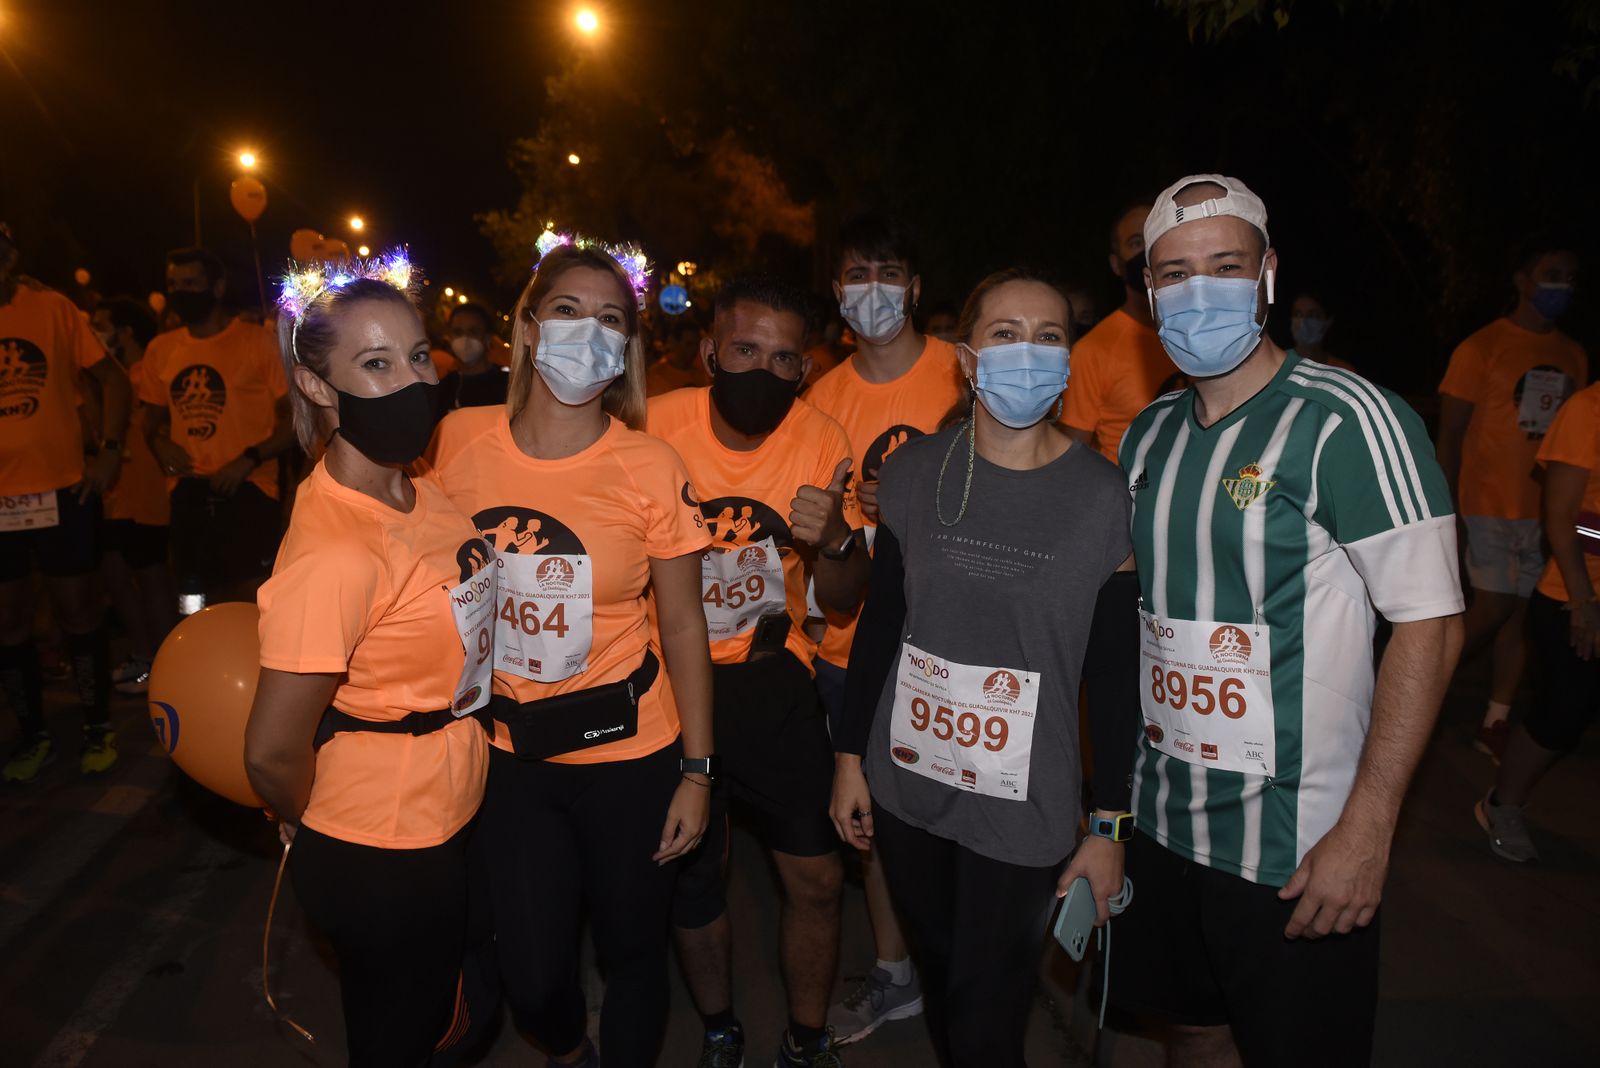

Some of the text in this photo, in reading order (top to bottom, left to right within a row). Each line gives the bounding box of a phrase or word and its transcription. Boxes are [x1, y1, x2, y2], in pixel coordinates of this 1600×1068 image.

[952, 535, 1018, 553] IMPERFECTLY
[1023, 549, 1056, 561] GREAT
[703, 574, 765, 609] 459
[500, 596, 569, 638] 464
[477, 627, 491, 665] 9
[1220, 652, 1249, 661] NOCTURNA
[1198, 664, 1242, 674] GUADALQUIVIR
[1151, 665, 1247, 719] 8956
[969, 703, 1008, 713] GUADALQUIVIR
[910, 697, 1009, 752] 9599
[1245, 750, 1264, 759] ABC
